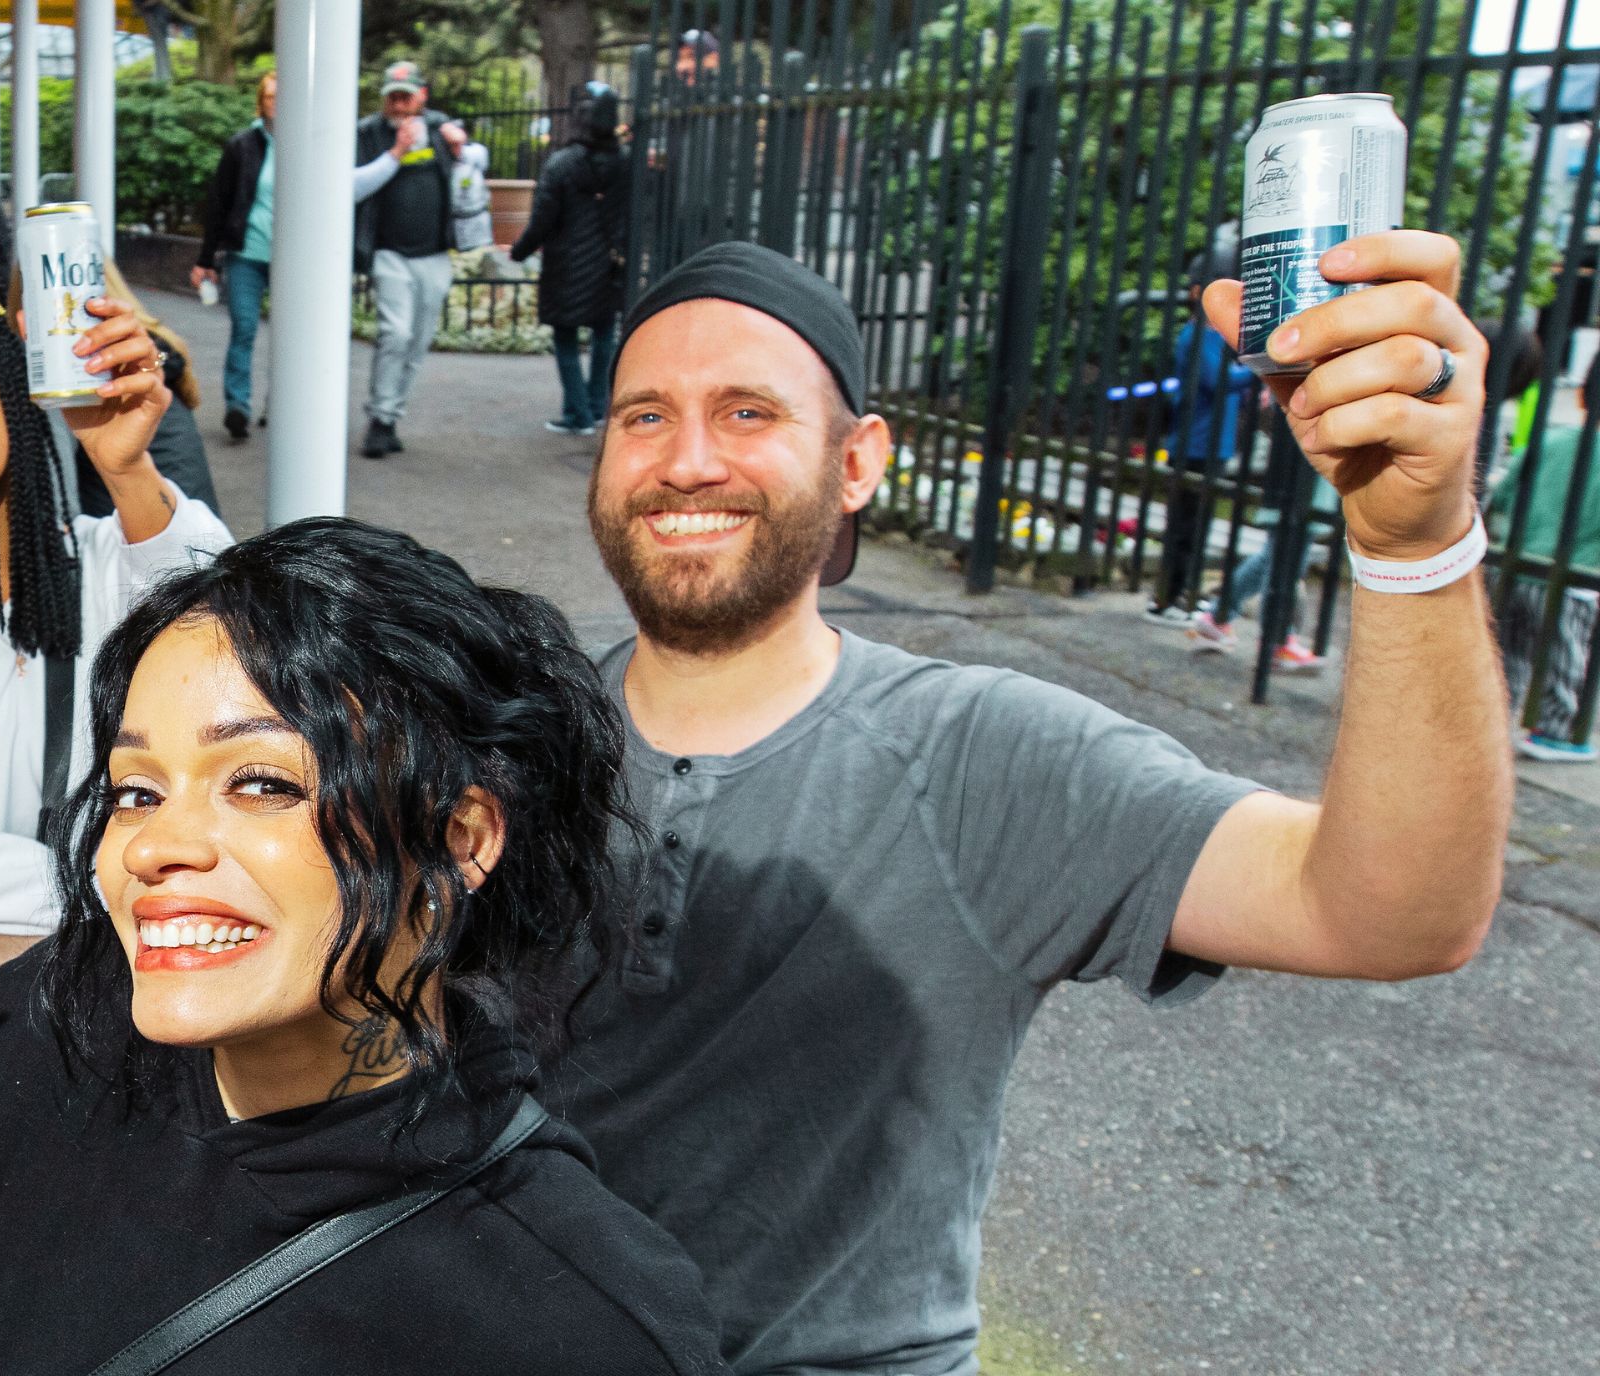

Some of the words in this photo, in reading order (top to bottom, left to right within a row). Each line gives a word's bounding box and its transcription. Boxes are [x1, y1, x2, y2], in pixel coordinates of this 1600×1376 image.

[1295, 112, 1324, 124] SPIRITS
[1252, 245, 1261, 256] OF
[1261, 243, 1275, 253] THE
[41, 251, 105, 290] Mode
[1269, 264, 1277, 272] of
[1265, 283, 1272, 291] of
